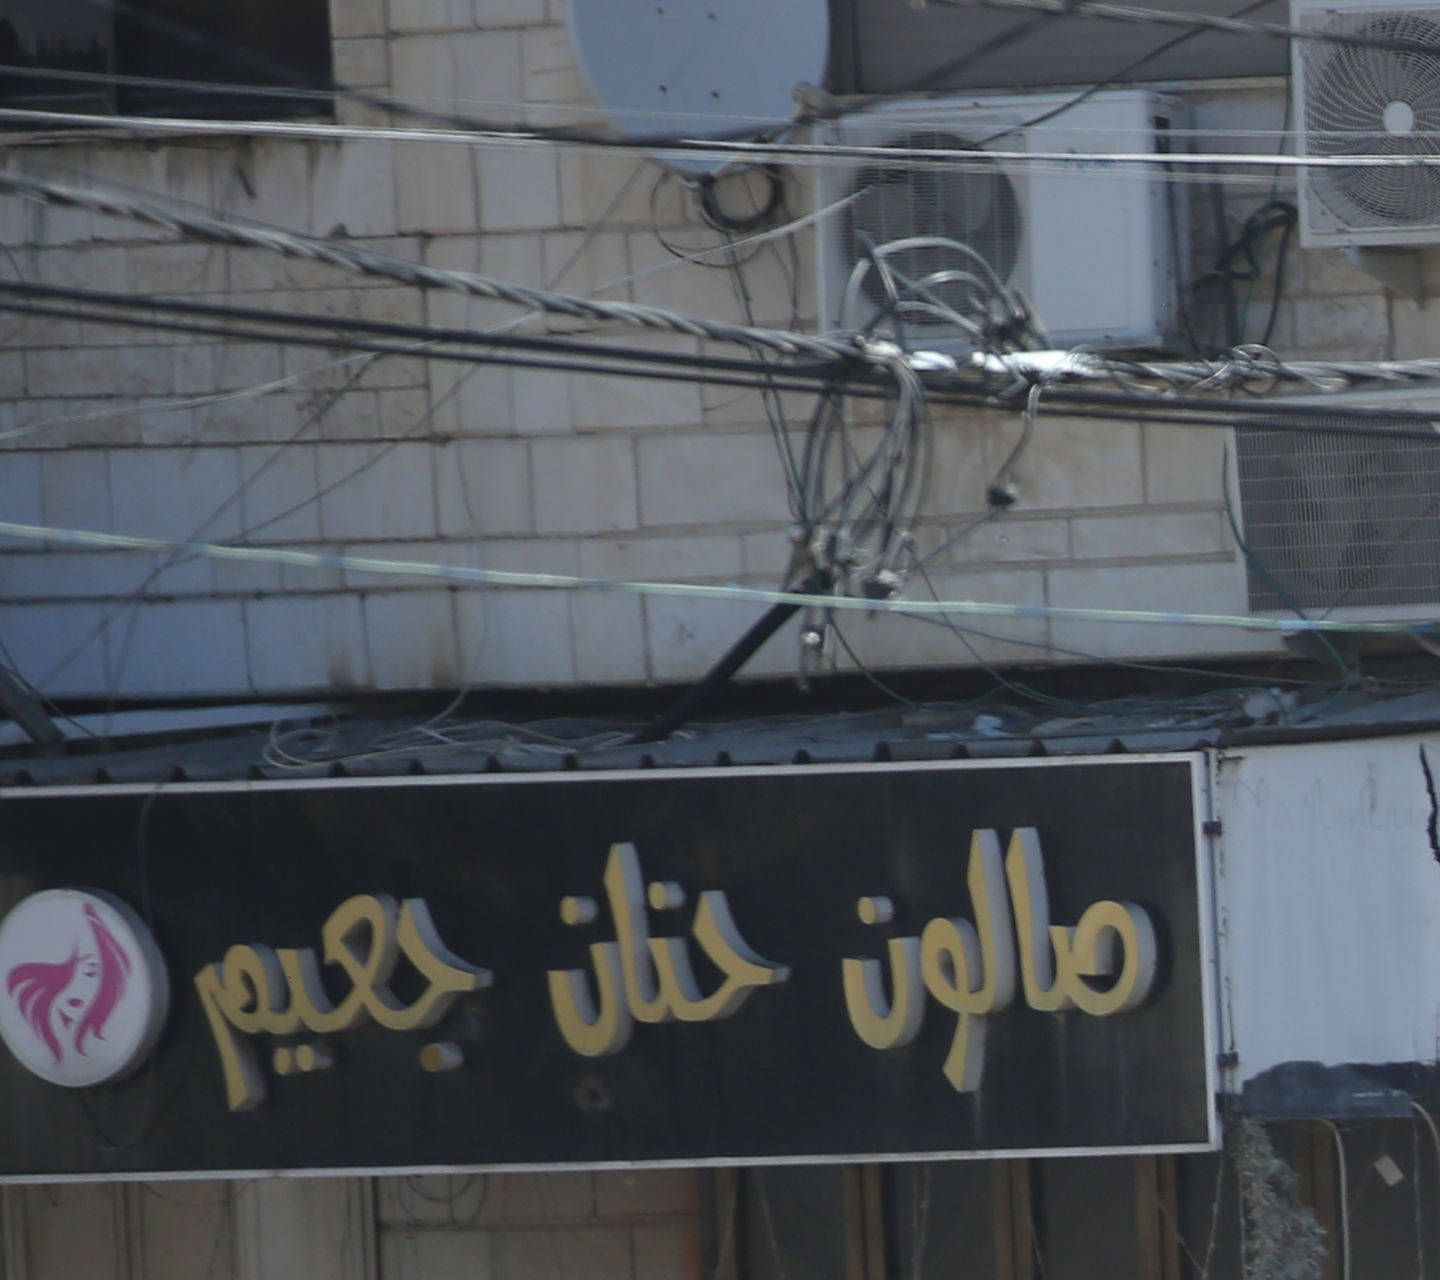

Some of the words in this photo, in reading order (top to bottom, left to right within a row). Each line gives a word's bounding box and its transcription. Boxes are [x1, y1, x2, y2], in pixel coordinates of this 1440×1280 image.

[195, 892, 494, 1113] جعيم
[548, 841, 791, 1058] حنان
[843, 825, 1158, 1093] صالون
